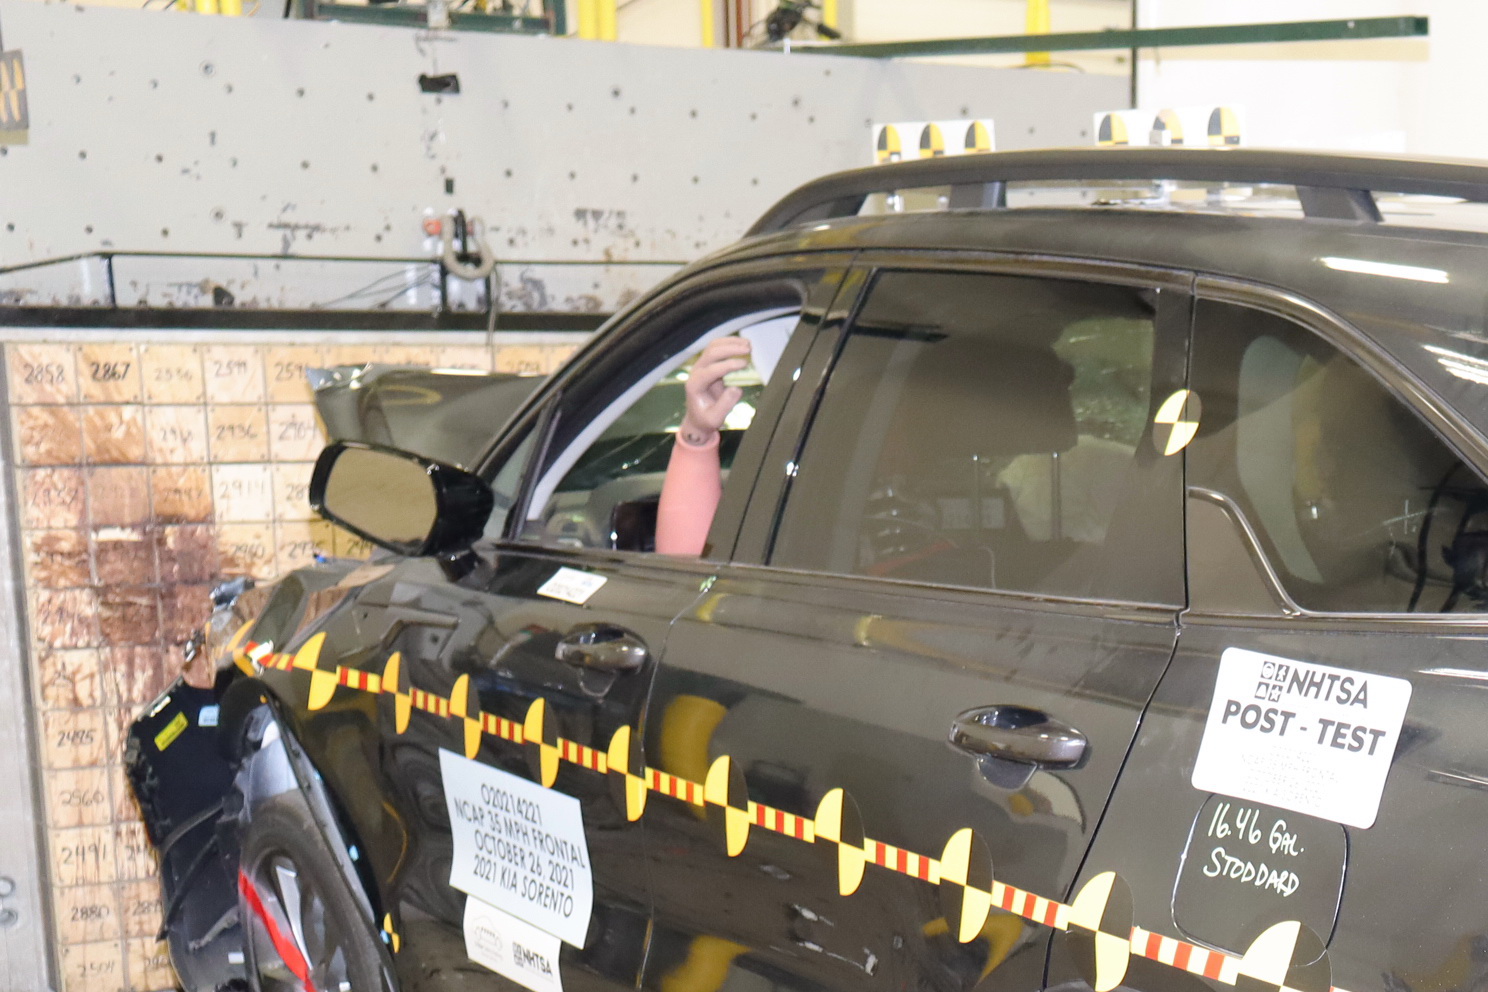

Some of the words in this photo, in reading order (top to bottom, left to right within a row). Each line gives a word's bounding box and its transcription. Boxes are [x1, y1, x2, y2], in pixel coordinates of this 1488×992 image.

[90, 361, 131, 383] 2867
[1286, 667, 1369, 709] NHTSA
[1221, 699, 1296, 737] POST
[1317, 718, 1386, 756] TEST
[454, 798, 486, 827] NCAP
[488, 812, 502, 834] 35
[504, 818, 530, 845] MPH
[532, 830, 586, 869] FRONTAL
[1208, 802, 1262, 845] 16.46
[474, 831, 527, 869] OCTOBER
[528, 854, 547, 880] 26,
[549, 861, 575, 891] 2021
[1203, 847, 1300, 897] STODDARD
[473, 856, 498, 883] 2021
[500, 867, 518, 894] KIA
[521, 879, 574, 918] SORENTO
[522, 946, 554, 977] NHTSA
